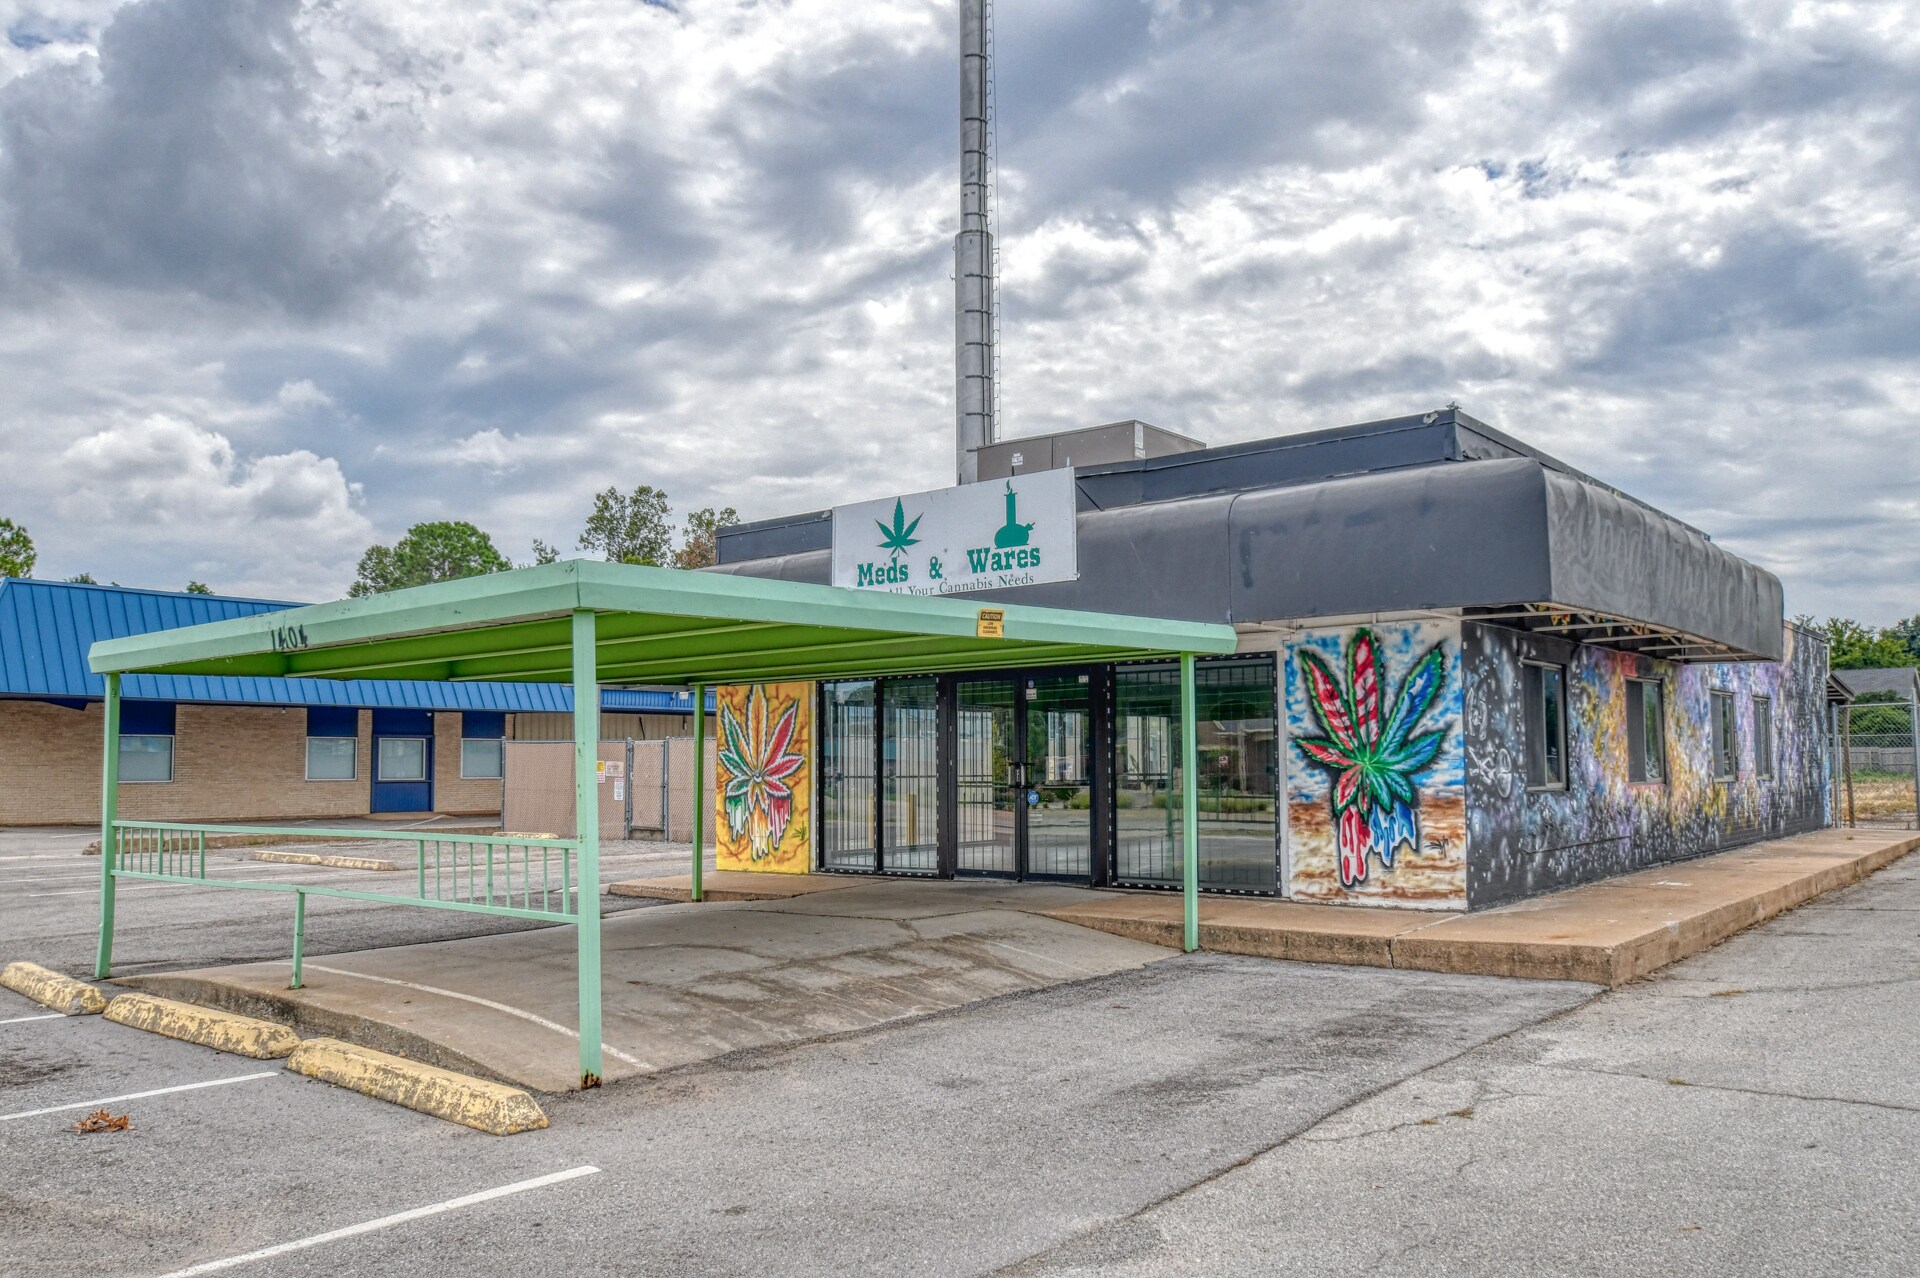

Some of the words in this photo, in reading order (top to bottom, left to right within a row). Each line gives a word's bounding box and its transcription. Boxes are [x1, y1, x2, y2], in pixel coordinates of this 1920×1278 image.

[857, 556, 909, 587] Meds
[928, 556, 943, 580] &
[966, 547, 1041, 574] Wares
[908, 585, 935, 596] Your
[939, 577, 993, 594] Cannabis
[998, 573, 1035, 588] Needs
[982, 612, 1001, 620] CAUTION
